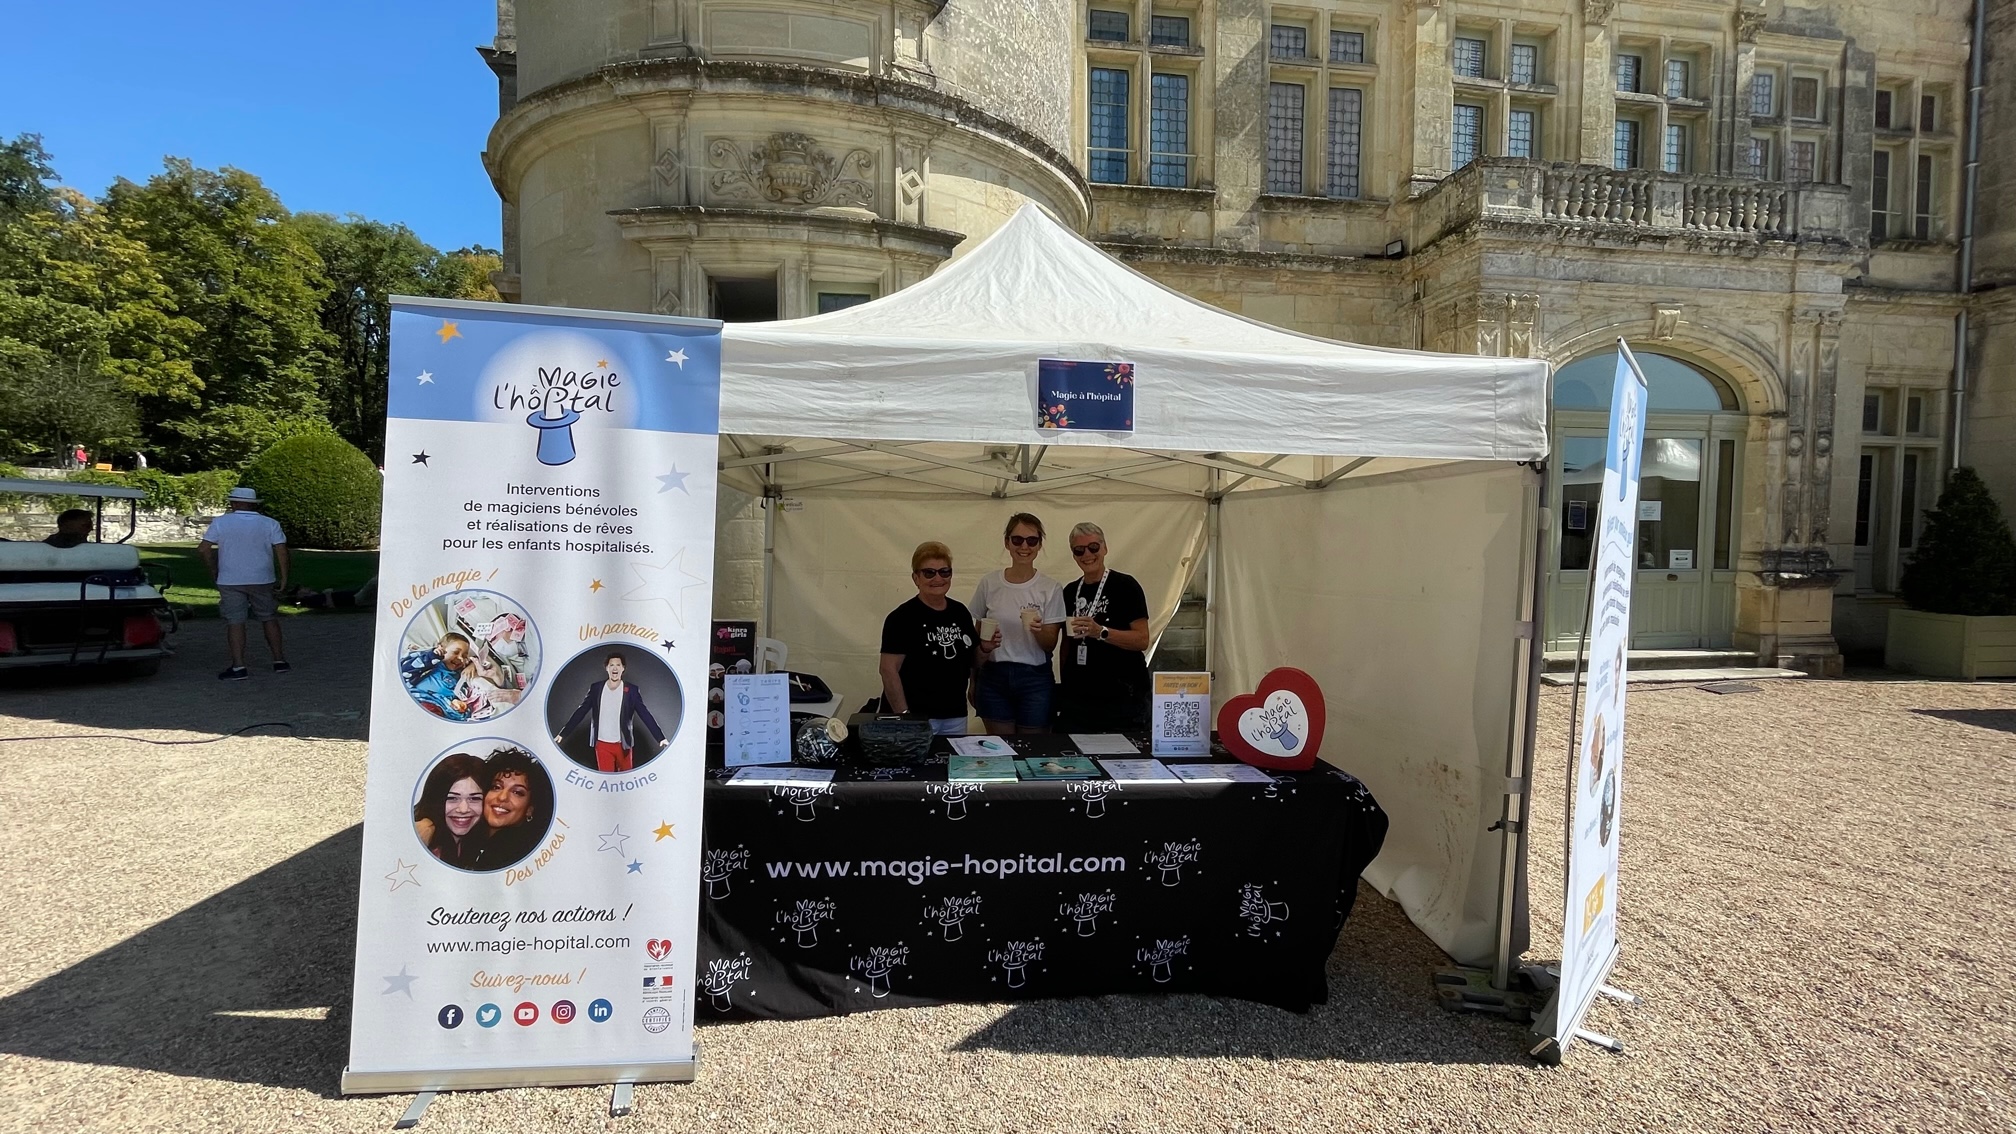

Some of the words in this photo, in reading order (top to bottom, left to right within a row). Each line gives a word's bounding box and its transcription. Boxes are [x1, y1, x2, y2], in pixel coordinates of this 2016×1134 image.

[1051, 390, 1078, 401] Magie
[1079, 391, 1085, 400] à
[1086, 391, 1121, 402] l'hôpital
[507, 483, 600, 497] Interventions
[464, 500, 482, 511] de
[488, 502, 560, 515] magiciens
[566, 503, 637, 516] bénévoles
[467, 519, 481, 530] et
[486, 519, 568, 532] réalisations
[573, 522, 591, 533] de
[596, 522, 632, 534] rêves
[443, 539, 478, 550] pour
[482, 538, 503, 549] les
[508, 539, 560, 550] enfants
[566, 540, 653, 554] hospitalisés.
[391, 598, 413, 619] De
[412, 583, 430, 601] la
[432, 569, 482, 592] magie
[580, 623, 600, 641] Un
[600, 623, 659, 642] parrain
[565, 769, 594, 790] Éric
[598, 772, 658, 793] Antoine
[505, 865, 533, 887] Des
[534, 833, 566, 871] rêves
[765, 851, 1126, 886] www.magie-hopital.com
[427, 906, 512, 932] Soutenez
[515, 908, 548, 924] nos
[552, 904, 617, 924] actions
[622, 903, 633, 921] !
[427, 935, 631, 954] www.magie-hopital.com
[470, 970, 572, 993] Suivez-nous
